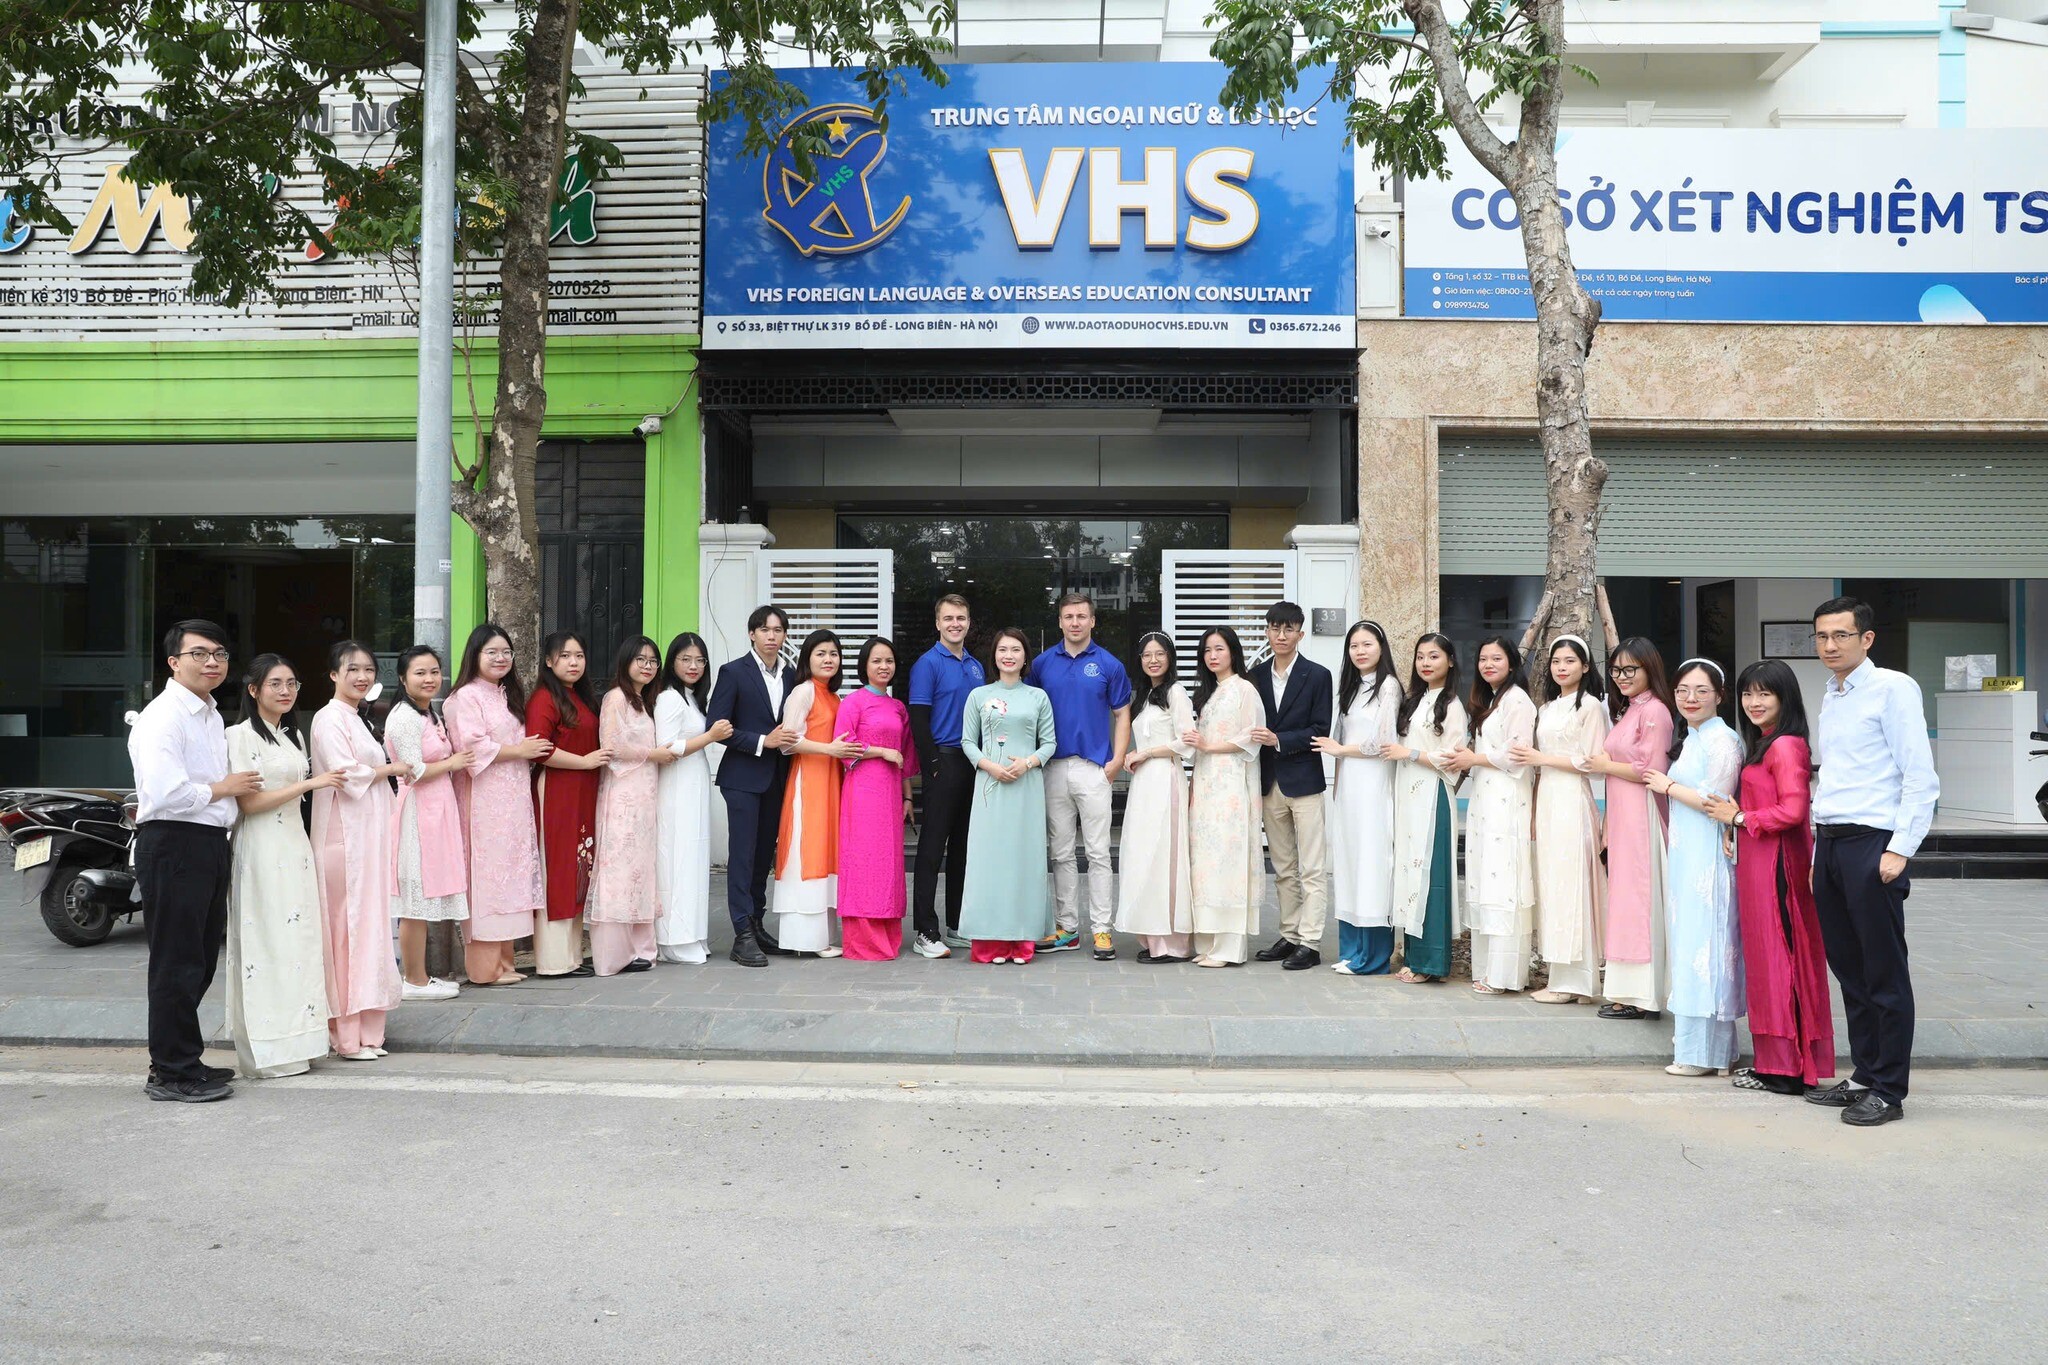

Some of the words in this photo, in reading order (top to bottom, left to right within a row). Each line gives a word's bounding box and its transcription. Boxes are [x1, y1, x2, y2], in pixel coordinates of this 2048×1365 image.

[931, 108, 1010, 126] TRUNG
[1014, 104, 1063, 126] TÂM
[1069, 107, 1144, 130] NGOẠI
[1150, 102, 1203, 126] NGỮ
[1206, 107, 1224, 125] &
[818, 165, 855, 198] VHS
[988, 147, 1260, 251] VHS
[1629, 176, 1735, 233] XÉT
[1747, 177, 1965, 248] NGHIỆM
[1983, 190, 2048, 234] TS
[1483, 272, 1492, 280] 32
[1645, 275, 1664, 284] Long
[1686, 275, 1697, 283] Hà
[1699, 275, 1712, 285] Nội
[2015, 275, 2031, 284] Bác
[31, 285, 49, 303] kề
[54, 288, 79, 303] 319
[85, 285, 107, 303] Bồ
[112, 285, 133, 303] Đề
[149, 285, 177, 303] Phố
[314, 285, 347, 301] Biên
[362, 285, 384, 300] HN
[747, 287, 783, 302] VHS
[787, 287, 865, 302] FOREIGN
[869, 286, 967, 302] LANGUAGE
[971, 286, 985, 301] &
[988, 285, 1082, 301] OVERSEAS
[1086, 285, 1191, 301] EDUCATION
[1194, 285, 1313, 303] CONSULTANT
[1617, 288, 1632, 296] các
[1633, 289, 1653, 298] ngày
[1654, 289, 1676, 299] trong
[352, 311, 395, 327] Email:
[731, 319, 746, 331] SỐ
[748, 322, 764, 333] 33,
[766, 320, 790, 333] BIỆT
[792, 320, 814, 333] THỰ
[816, 322, 829, 331] LK
[831, 321, 850, 331] 319
[895, 320, 925, 331] LONG
[927, 319, 952, 331] BIÊN
[960, 318, 976, 330] HÀ
[978, 319, 998, 332] NỘI
[1044, 319, 1229, 332] WWW.DAOTAODUHOCVHS.EDU.VN
[1269, 321, 1342, 333] 0365.672.246
[1321, 610, 1337, 622] 33
